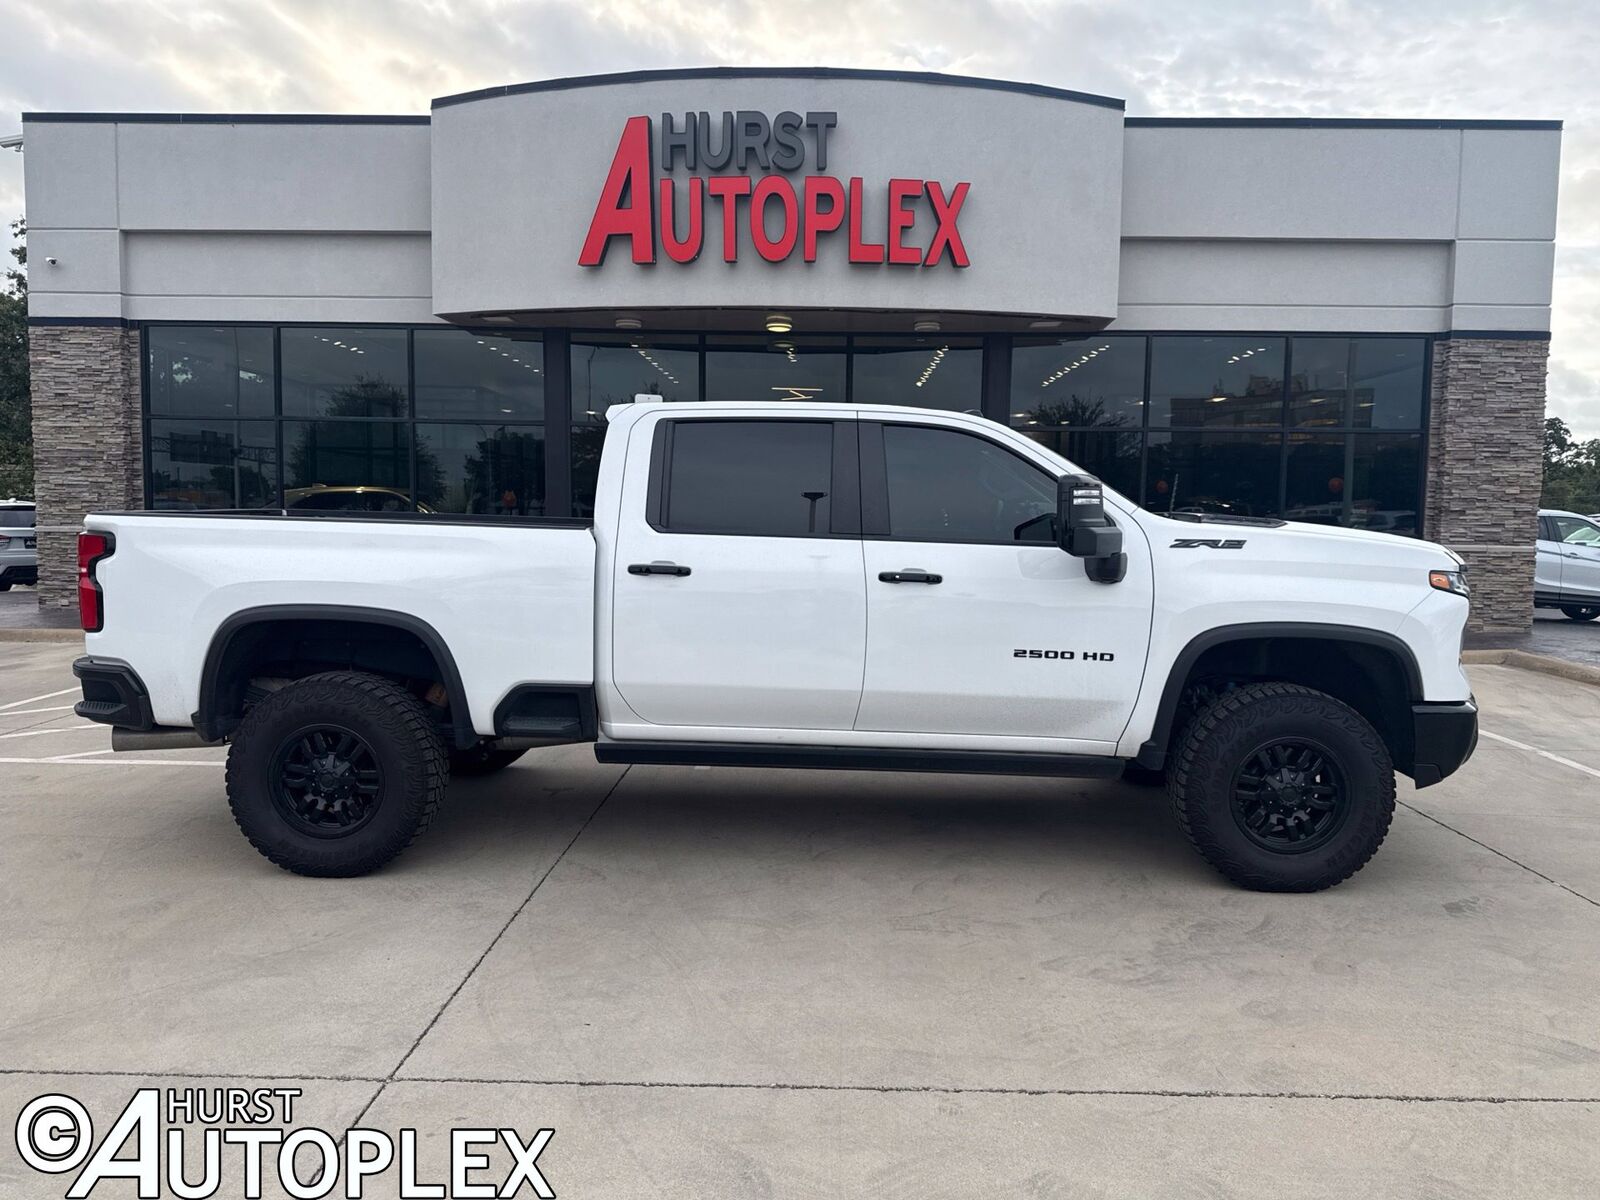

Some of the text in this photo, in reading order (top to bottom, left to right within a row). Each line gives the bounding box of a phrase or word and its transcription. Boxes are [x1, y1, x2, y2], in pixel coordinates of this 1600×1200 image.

[661, 111, 838, 171] HURST
[578, 115, 971, 268] AUTOPLEX
[1169, 538, 1247, 550] ZR2
[1013, 649, 1115, 662] 2500 HD
